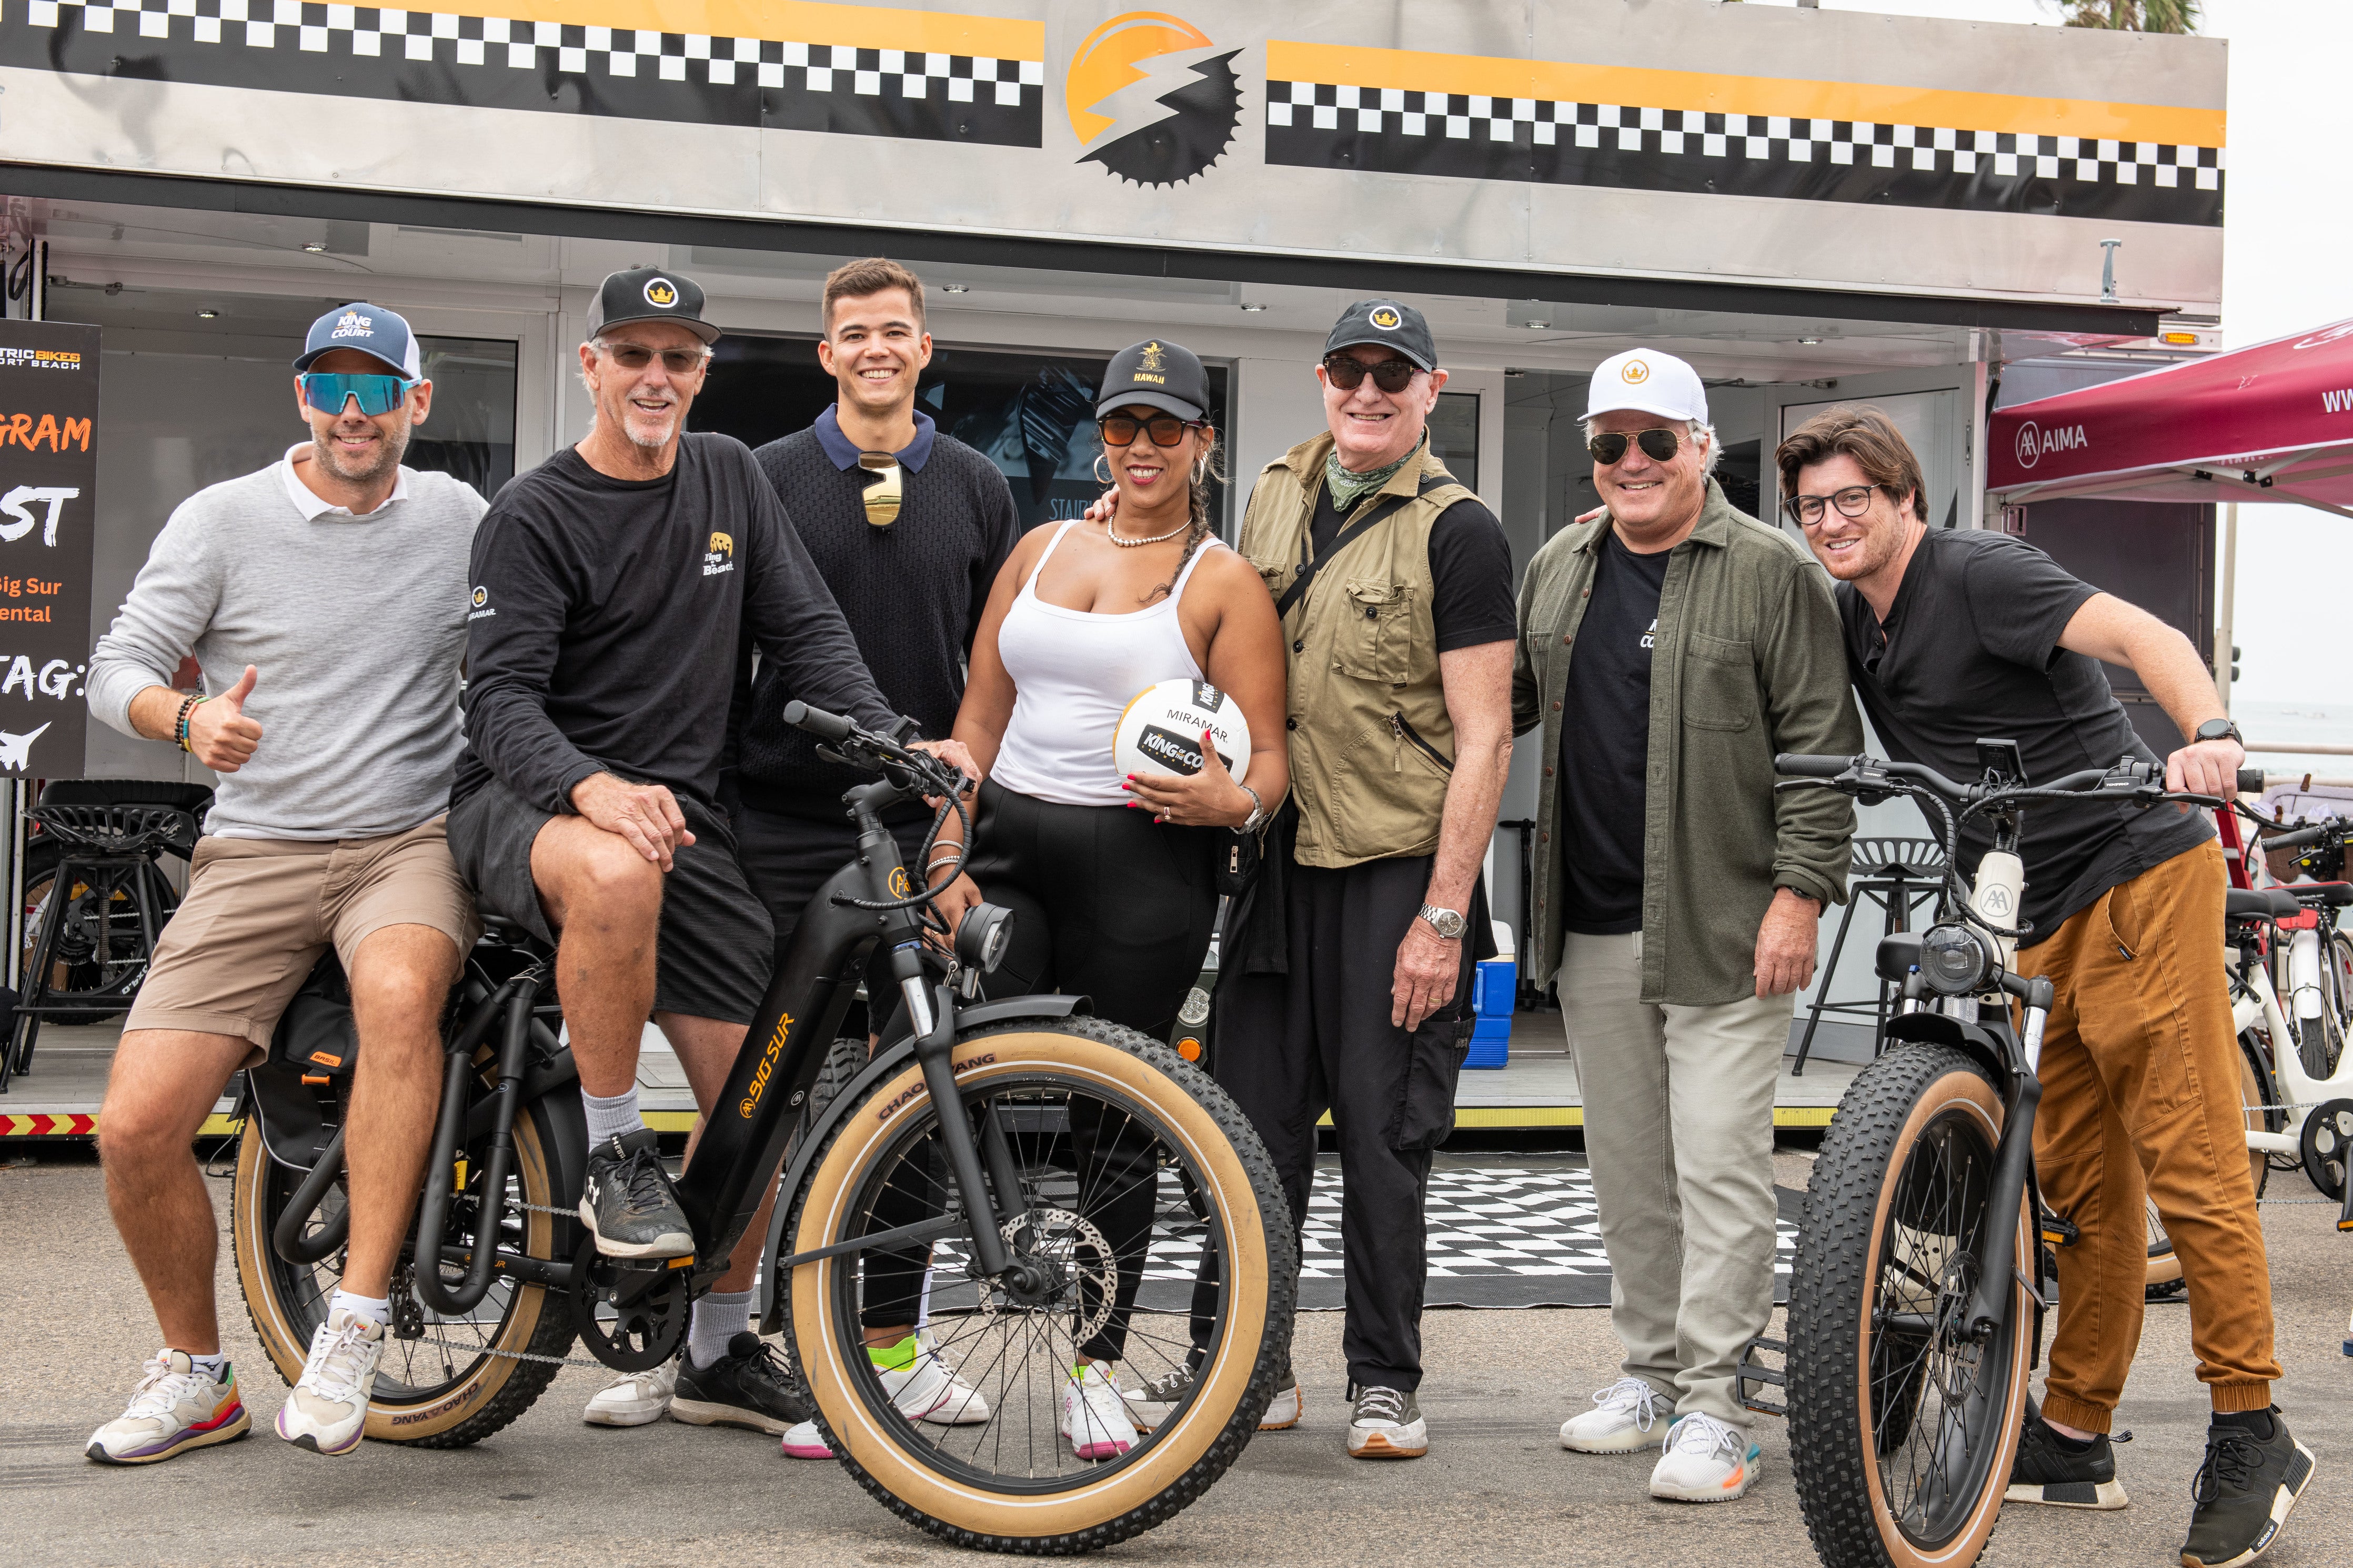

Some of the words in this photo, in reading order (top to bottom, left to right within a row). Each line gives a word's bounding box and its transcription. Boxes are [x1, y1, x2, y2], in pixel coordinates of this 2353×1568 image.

[337, 315, 373, 327] KING
[331, 329, 374, 339] COURT
[31, 360, 81, 370] BEACH
[2042, 424, 2088, 454] AIMA
[26, 578, 62, 595] Sur
[1143, 732, 1180, 757] KING
[314, 1055, 336, 1065] BASIL
[749, 1057, 772, 1102] BIG
[767, 1013, 795, 1064] SUR
[2257, 1530, 2271, 1547] adidas
